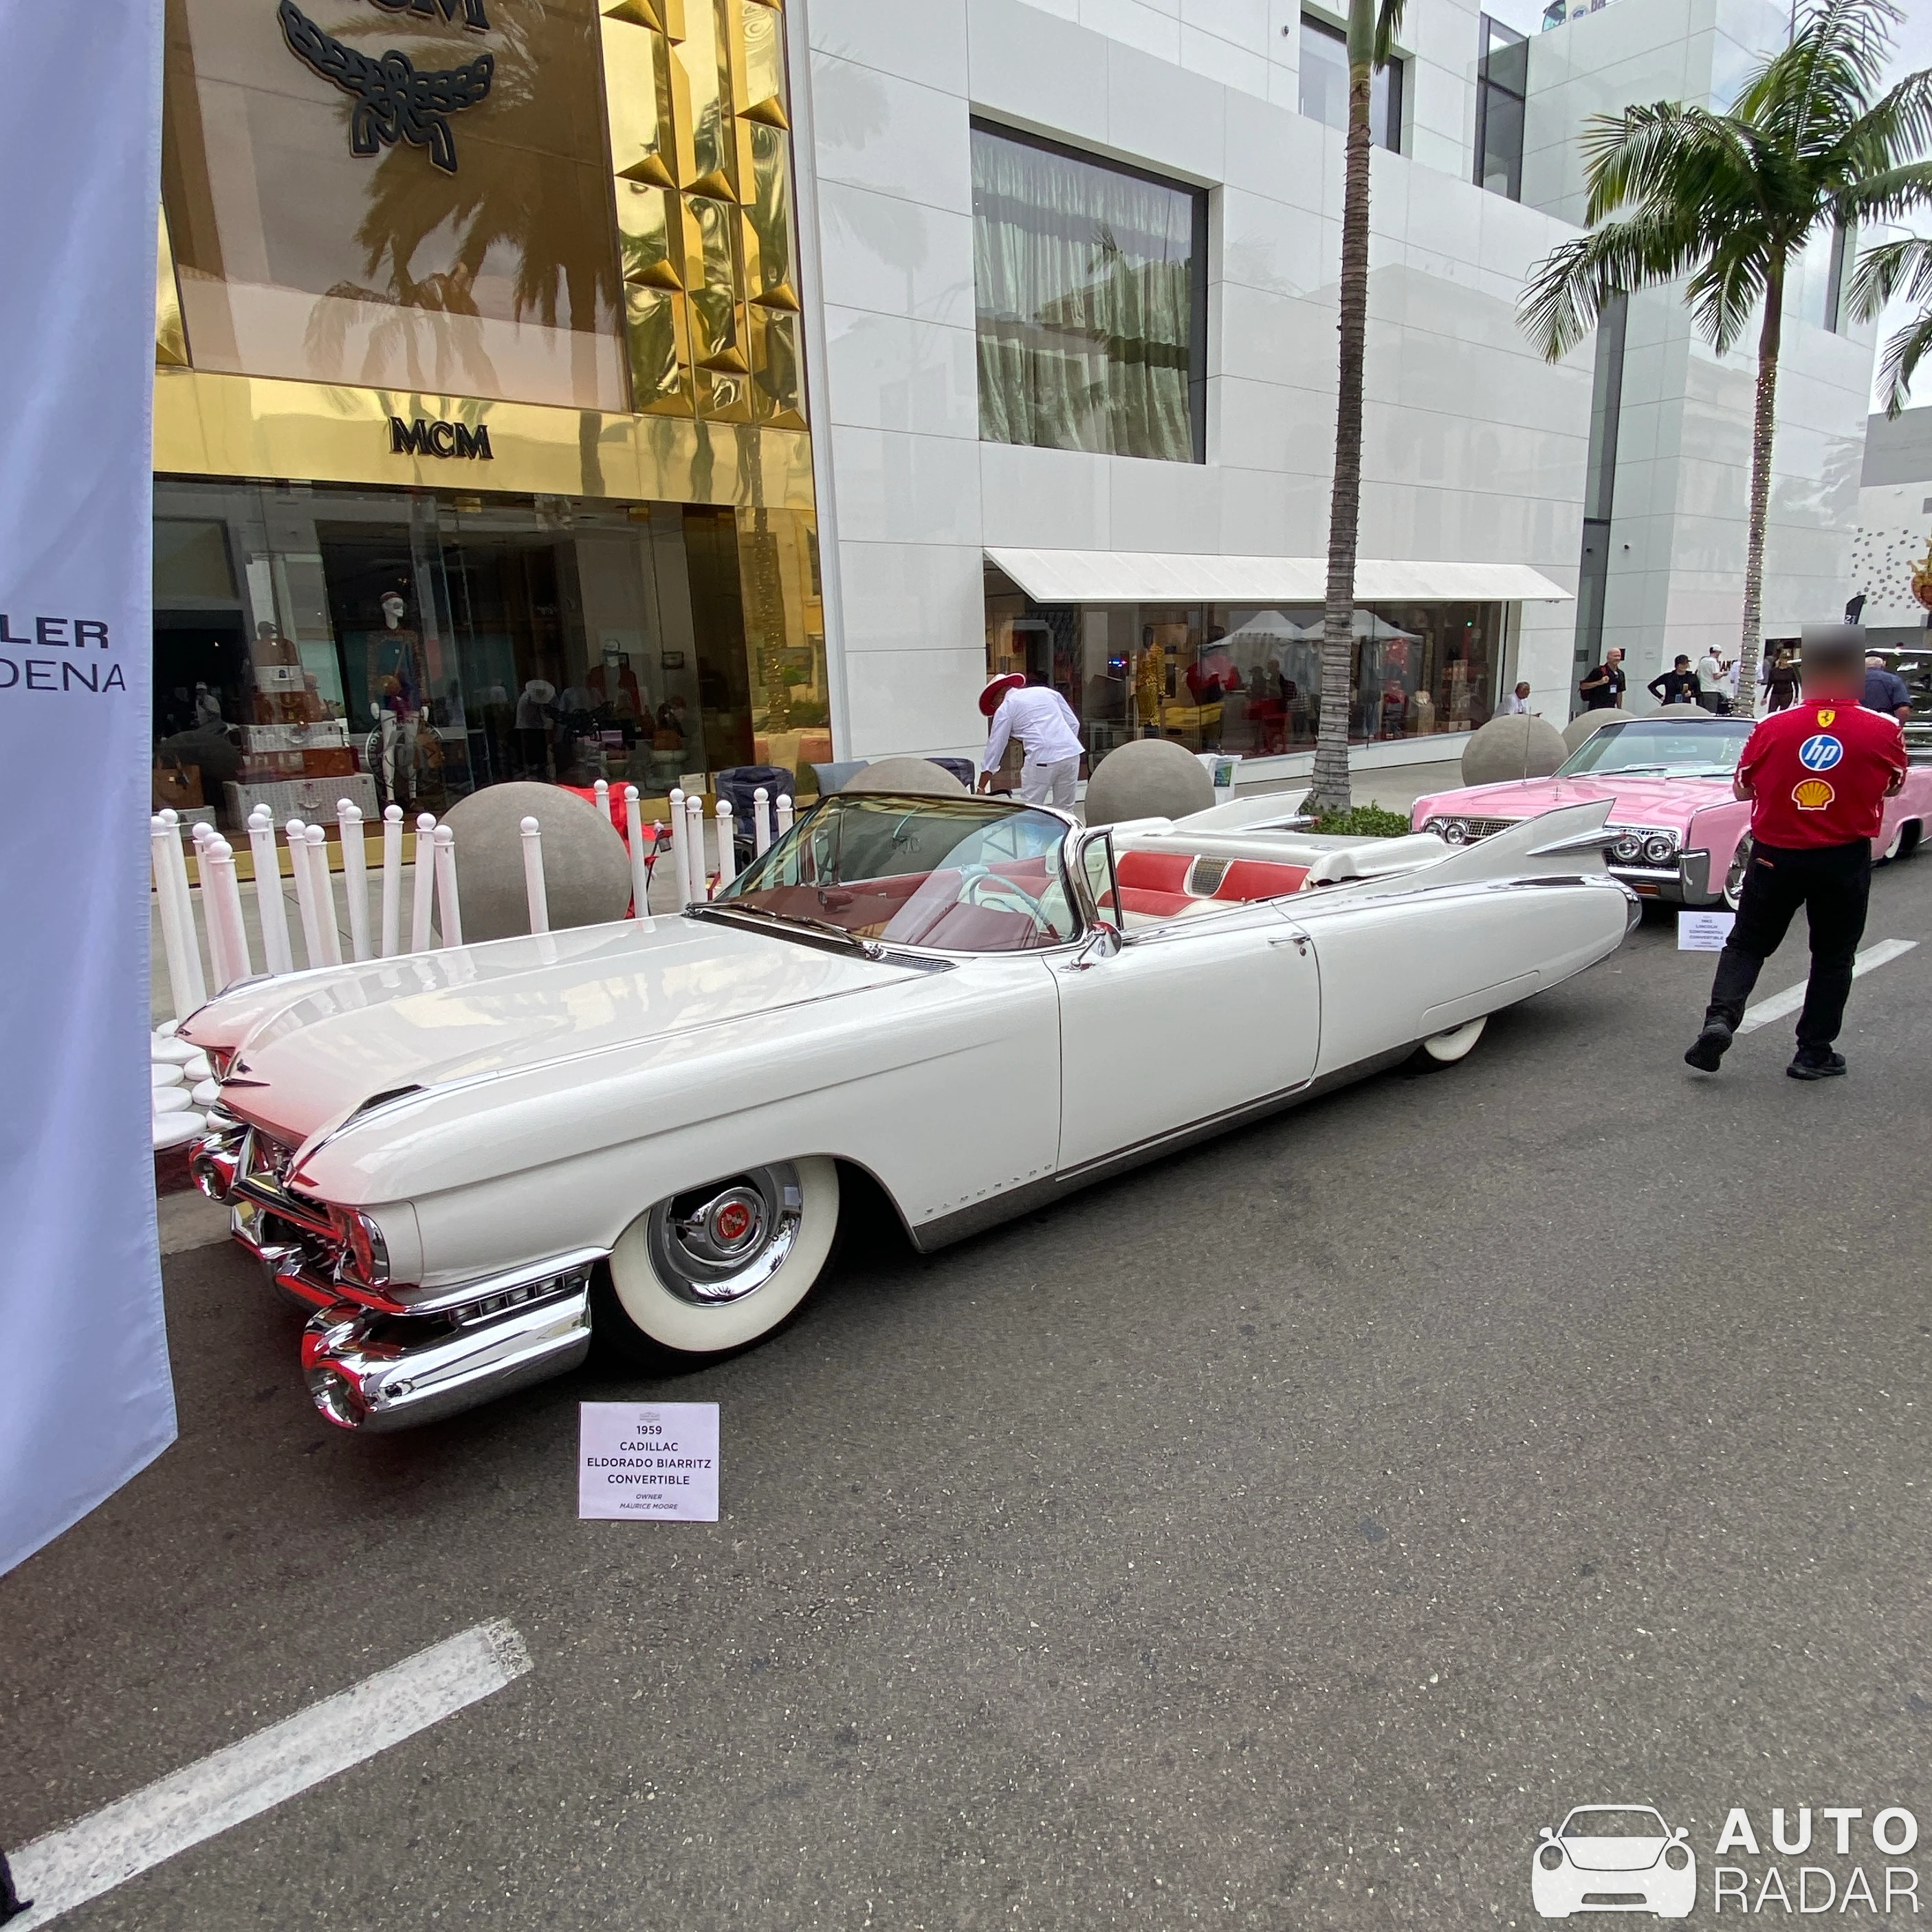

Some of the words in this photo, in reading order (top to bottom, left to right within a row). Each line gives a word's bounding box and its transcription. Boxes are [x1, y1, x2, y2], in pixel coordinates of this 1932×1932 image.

[388, 416, 494, 461] MCM
[0, 614, 109, 648] LER
[1804, 736, 1838, 769] hp
[637, 1425, 662, 1435] 1959
[619, 1441, 679, 1451] CADILLAC
[586, 1458, 653, 1468] ELDORADO
[657, 1459, 712, 1469] BIARRITZ
[607, 1474, 690, 1485] CONVERTIBLE
